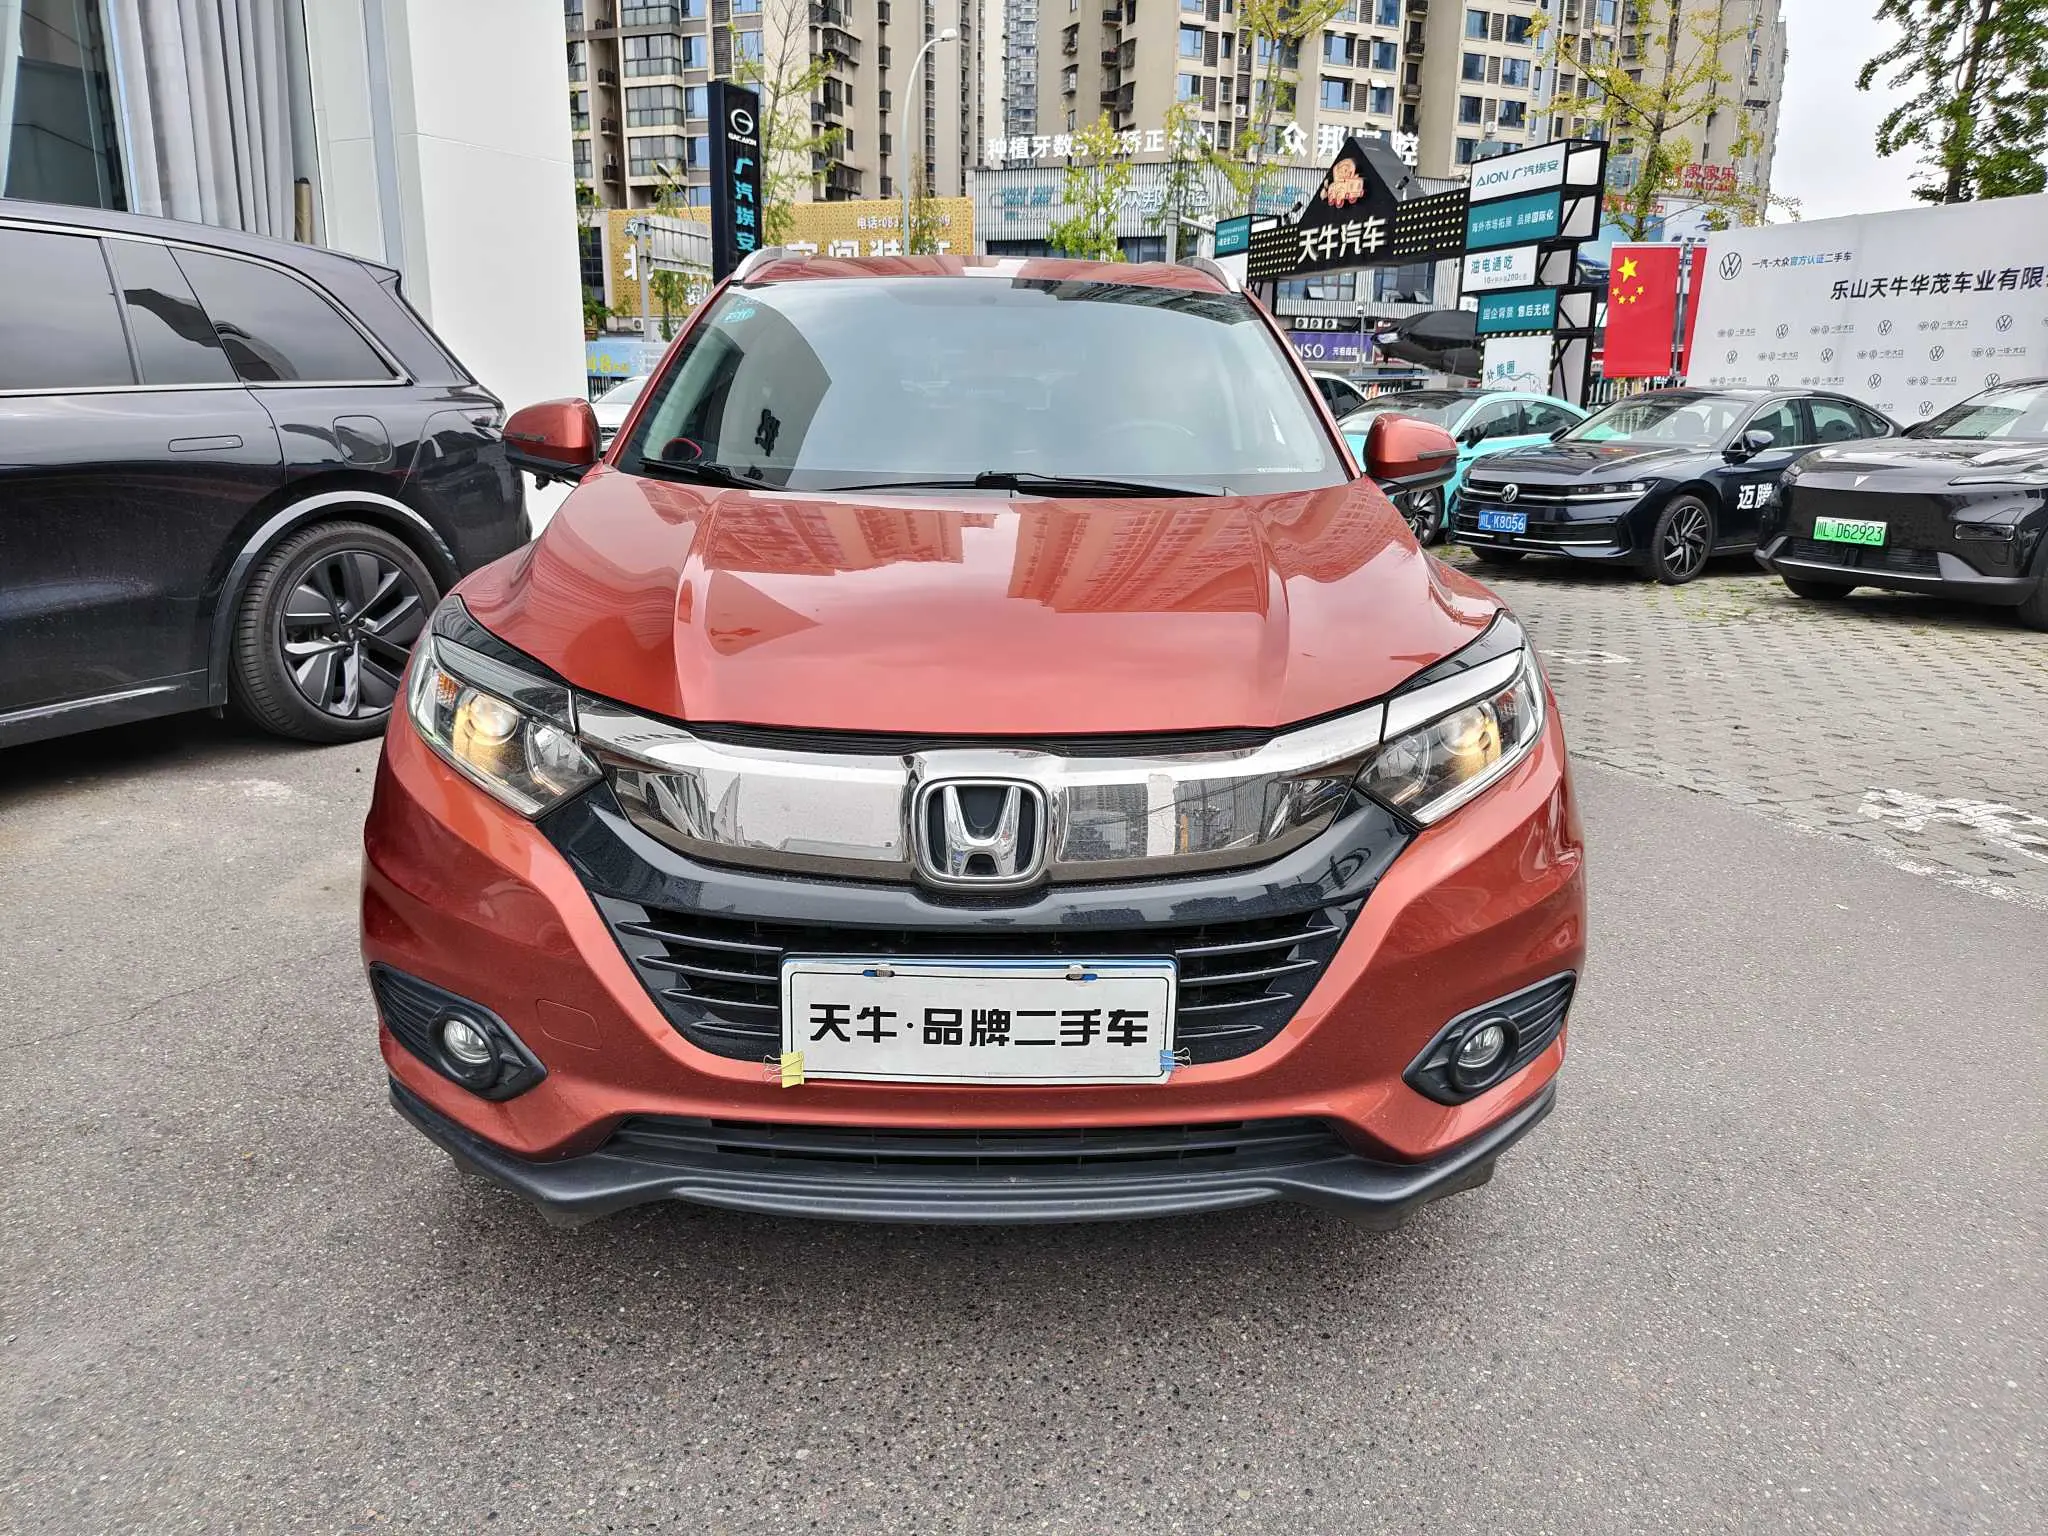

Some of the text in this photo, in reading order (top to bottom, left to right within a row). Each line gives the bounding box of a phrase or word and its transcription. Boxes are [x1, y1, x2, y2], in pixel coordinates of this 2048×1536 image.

[1475, 159, 1559, 187] AION 广汽埃安
[734, 156, 756, 253] 广汽埃安
[1297, 215, 1388, 265] 天牛汽车
[1751, 250, 1853, 269] 一汽-大众官方认证二手车
[1830, 265, 2048, 300] 乐山天牛华茂车业有限
[809, 1002, 1149, 1047] 天牛·品牌二手车
